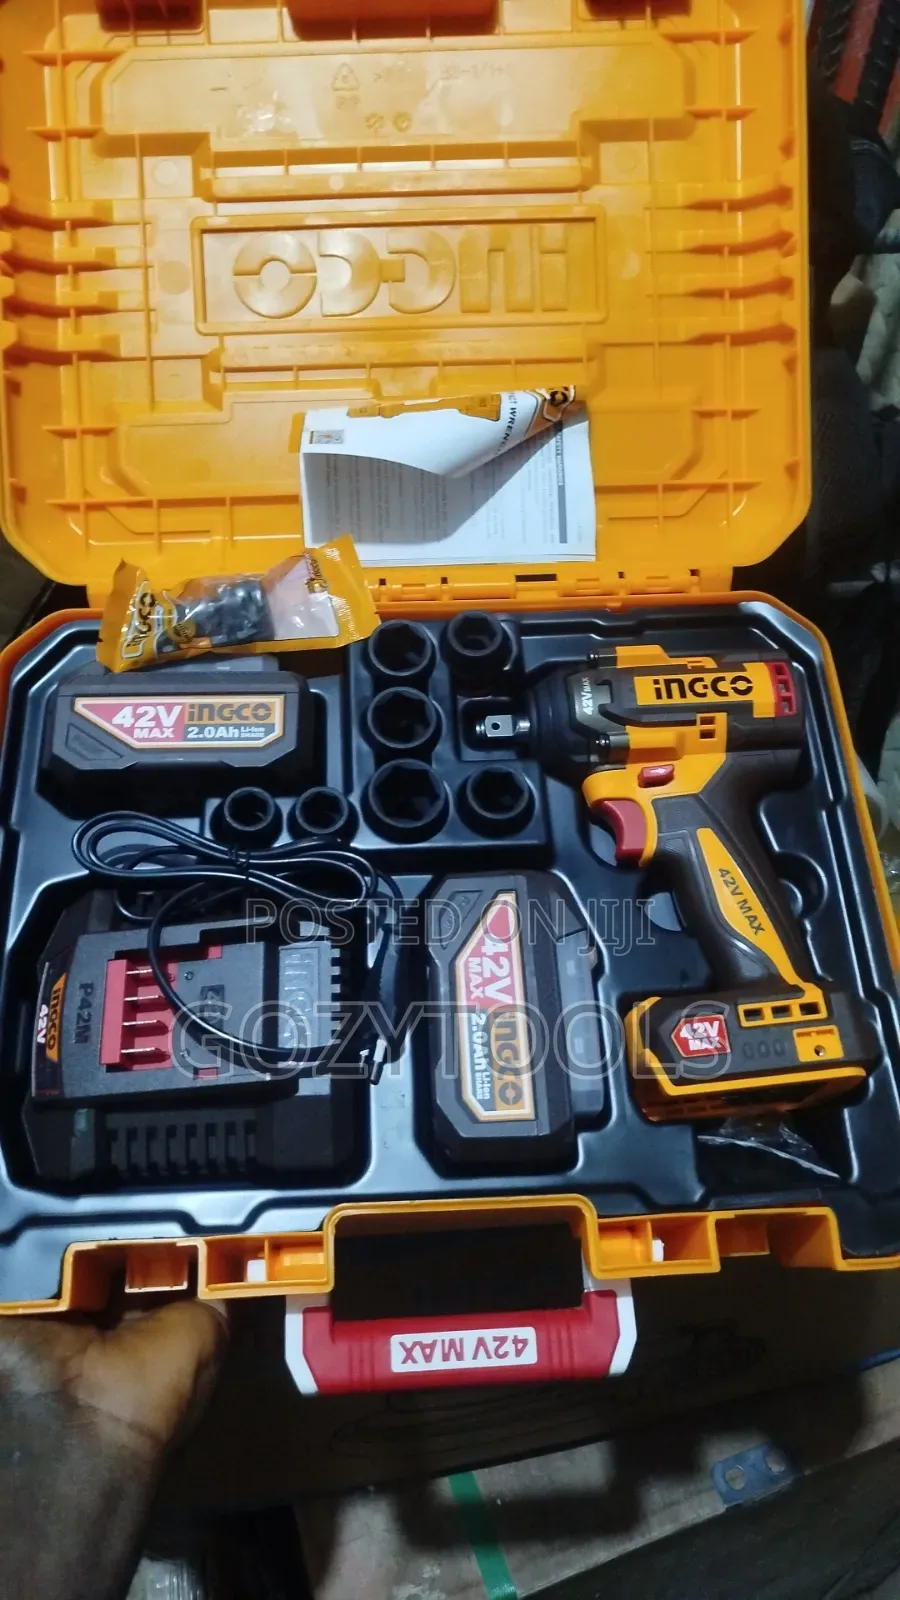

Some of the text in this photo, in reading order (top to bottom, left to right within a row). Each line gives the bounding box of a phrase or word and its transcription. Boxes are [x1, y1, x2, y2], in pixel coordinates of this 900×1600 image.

[111, 705, 184, 728] 42V
[582, 692, 593, 715] 42V
[133, 727, 175, 739] MAX
[187, 726, 240, 739] 2.0Ah
[719, 868, 766, 936] 42V MAX
[468, 957, 484, 999] MAX
[481, 936, 513, 1004] 42V
[37, 1004, 48, 1044] 42V
[398, 1335, 529, 1364] 42V MAX
